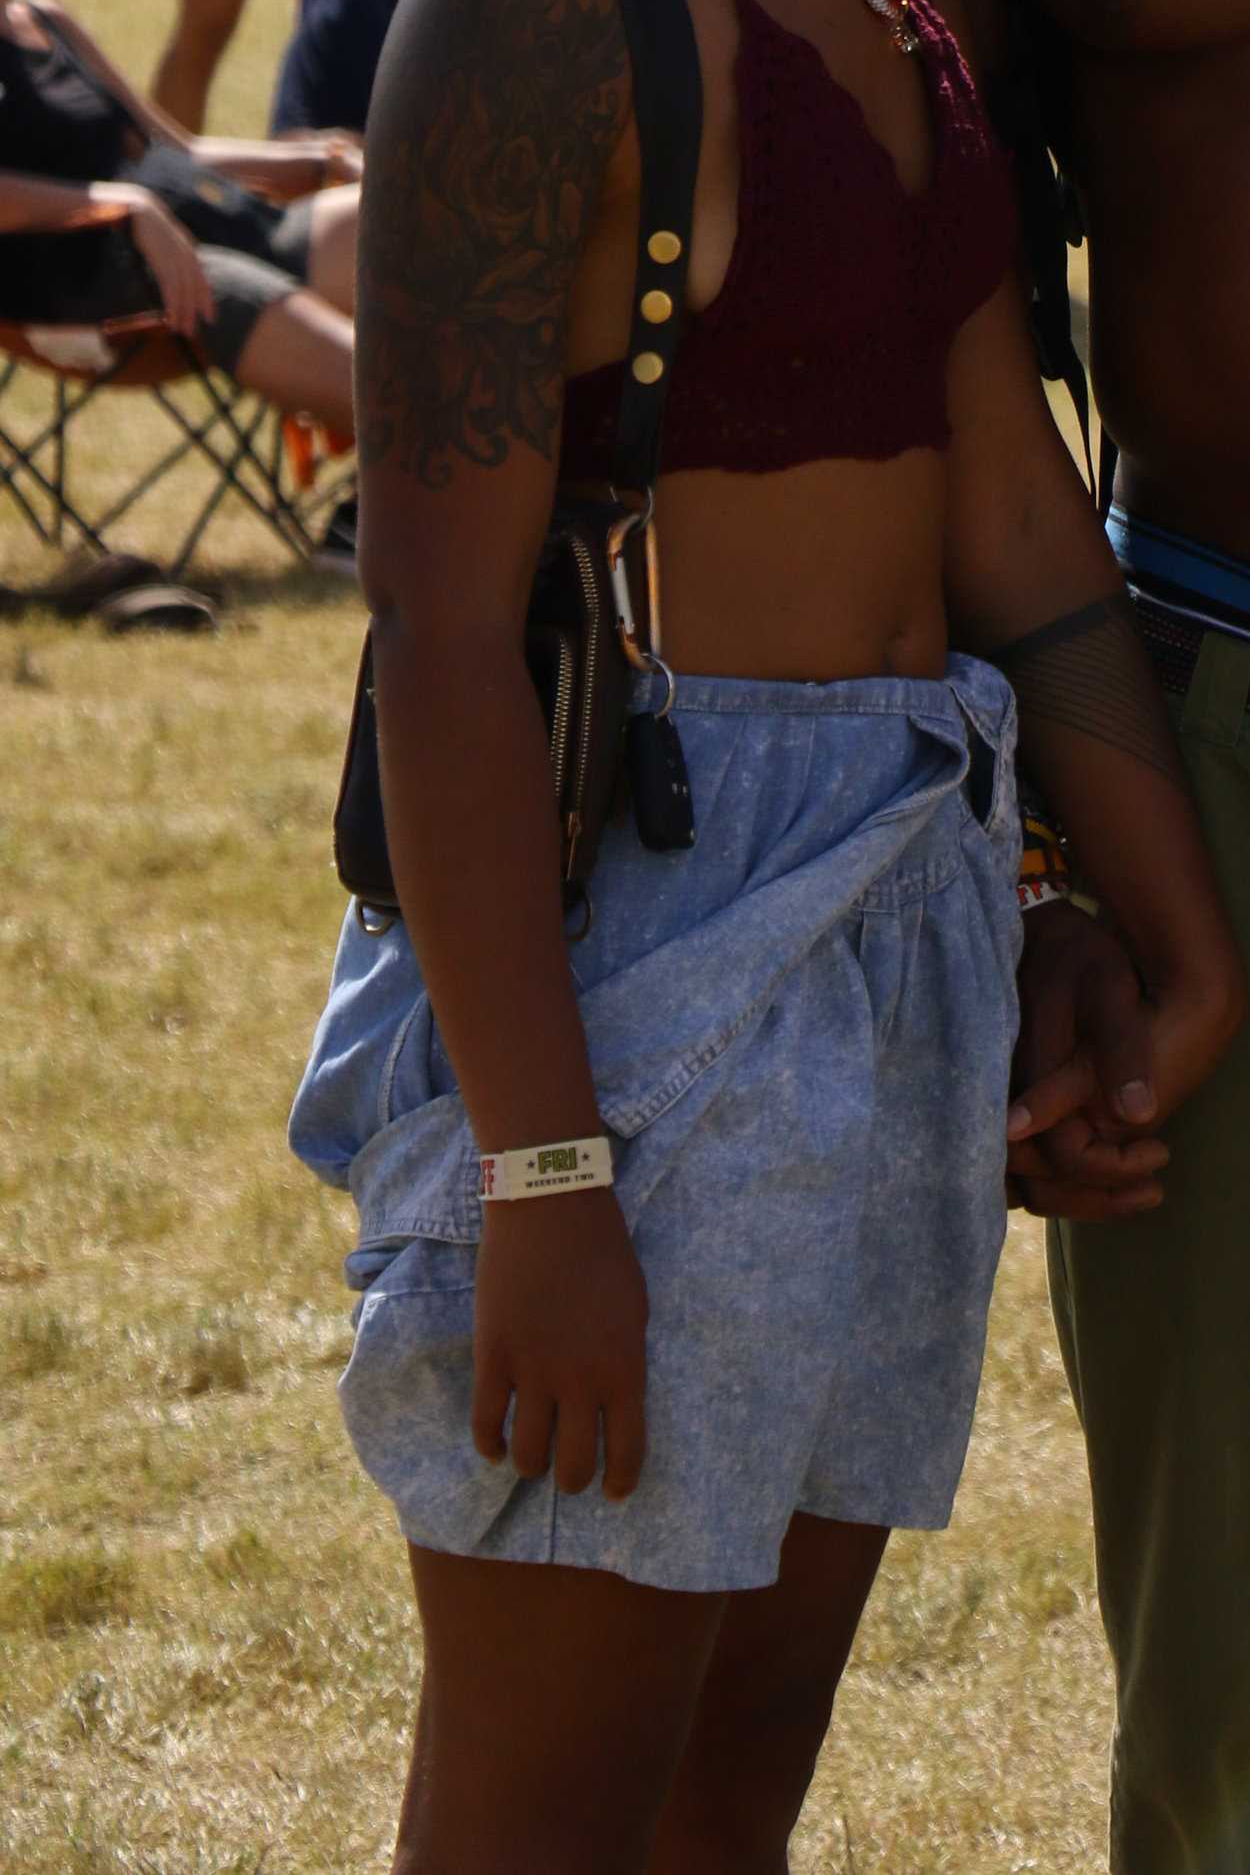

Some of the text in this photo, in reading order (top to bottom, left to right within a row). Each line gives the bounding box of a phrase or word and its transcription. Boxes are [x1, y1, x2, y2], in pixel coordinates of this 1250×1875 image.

[538, 1147, 577, 1173] FRI
[525, 1173, 594, 1188] WEEKEND TWO
